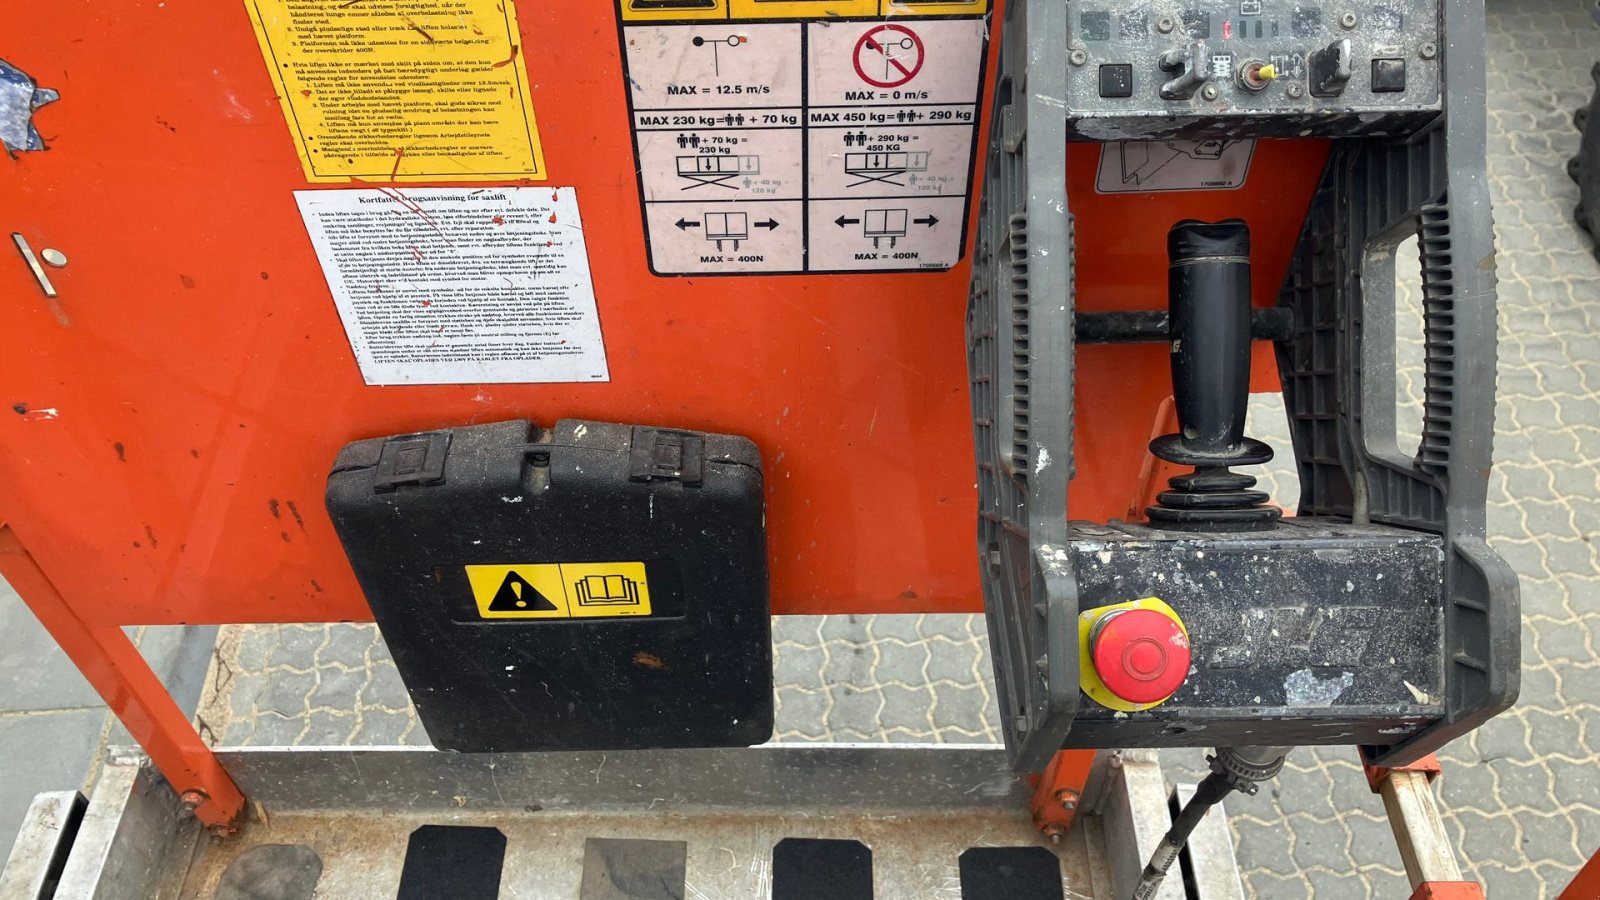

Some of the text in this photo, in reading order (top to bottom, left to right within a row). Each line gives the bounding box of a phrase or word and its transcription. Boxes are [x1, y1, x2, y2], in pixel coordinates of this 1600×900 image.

[668, 86, 696, 94] MAX
[717, 86, 742, 94] 12.5
[747, 85, 770, 94] m/s
[846, 92, 874, 100] MAX
[893, 91, 900, 99] 0
[905, 91, 928, 99] m/s
[640, 117, 668, 125] MAX
[763, 115, 777, 123] 70
[782, 115, 796, 124] kg
[811, 114, 839, 122] MAX
[844, 113, 866, 121] 450
[930, 111, 952, 119] 290
[956, 111, 972, 122] kg
[896, 135, 908, 143] kg
